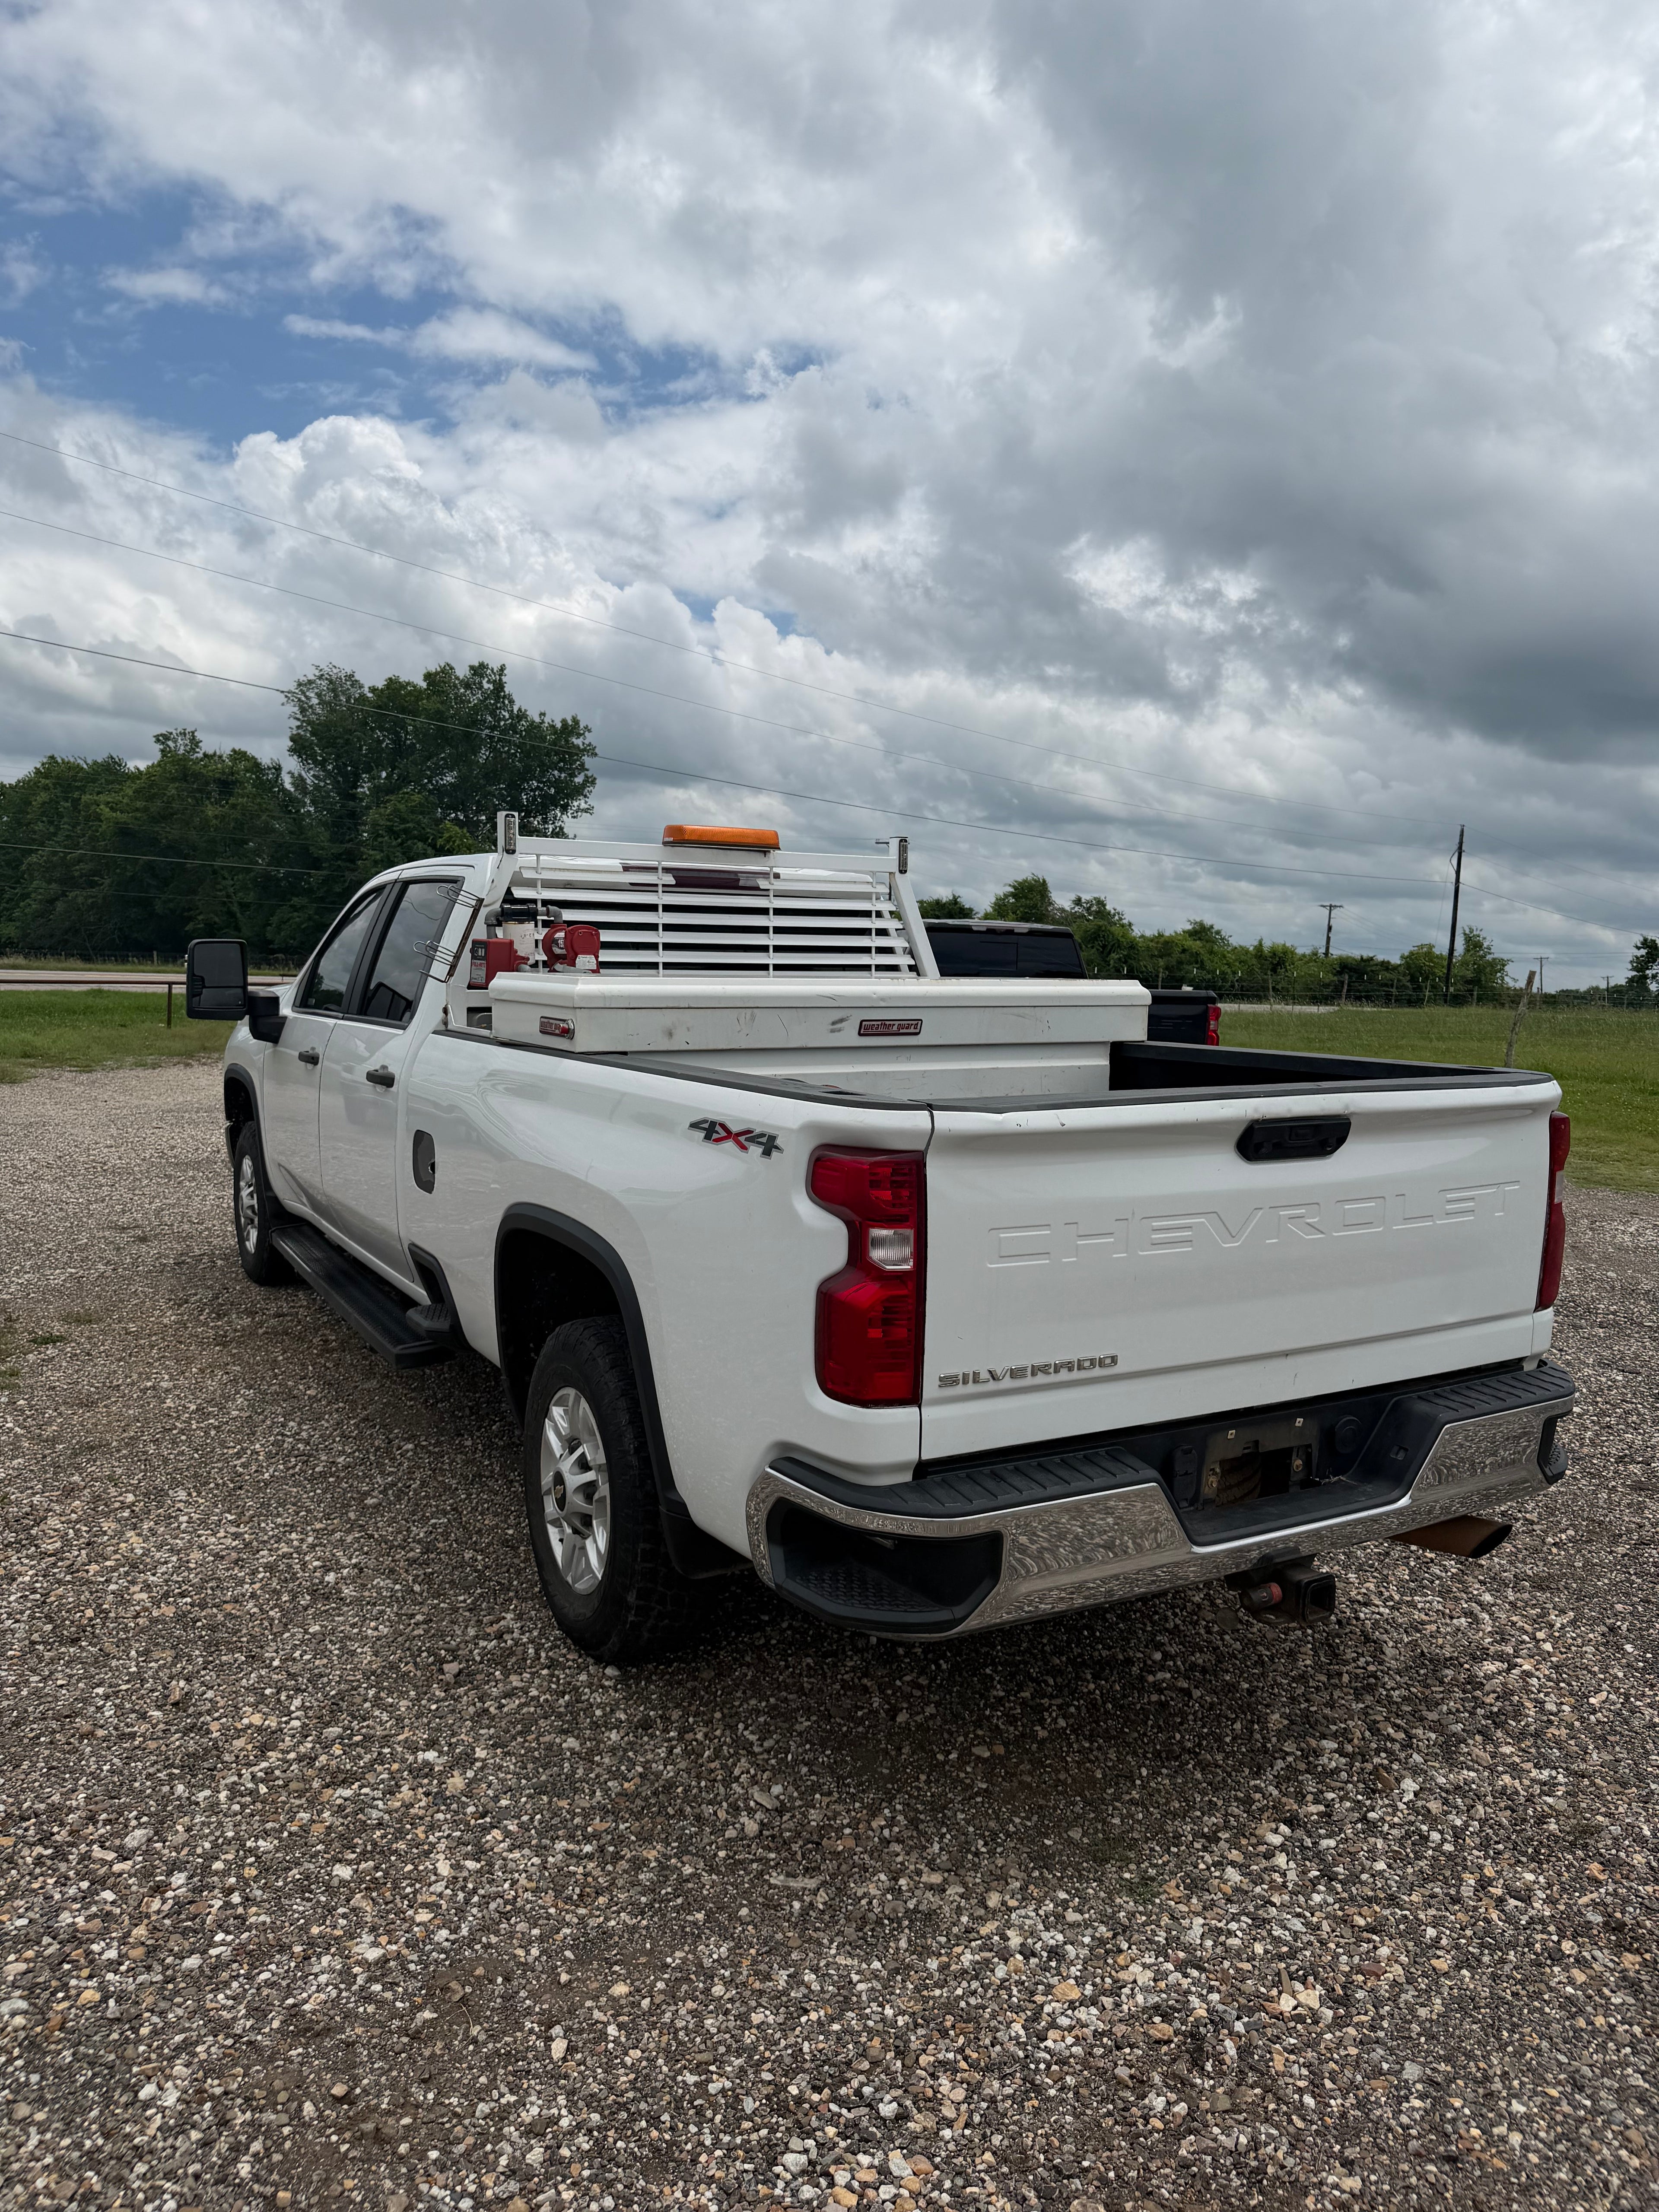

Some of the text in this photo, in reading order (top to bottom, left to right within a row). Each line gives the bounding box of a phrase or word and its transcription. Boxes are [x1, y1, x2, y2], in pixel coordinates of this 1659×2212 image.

[863, 1021, 919, 1032] weather guard
[987, 1180, 1520, 1267] CHEVROLET
[938, 1353, 1118, 1388] SILVERADO
